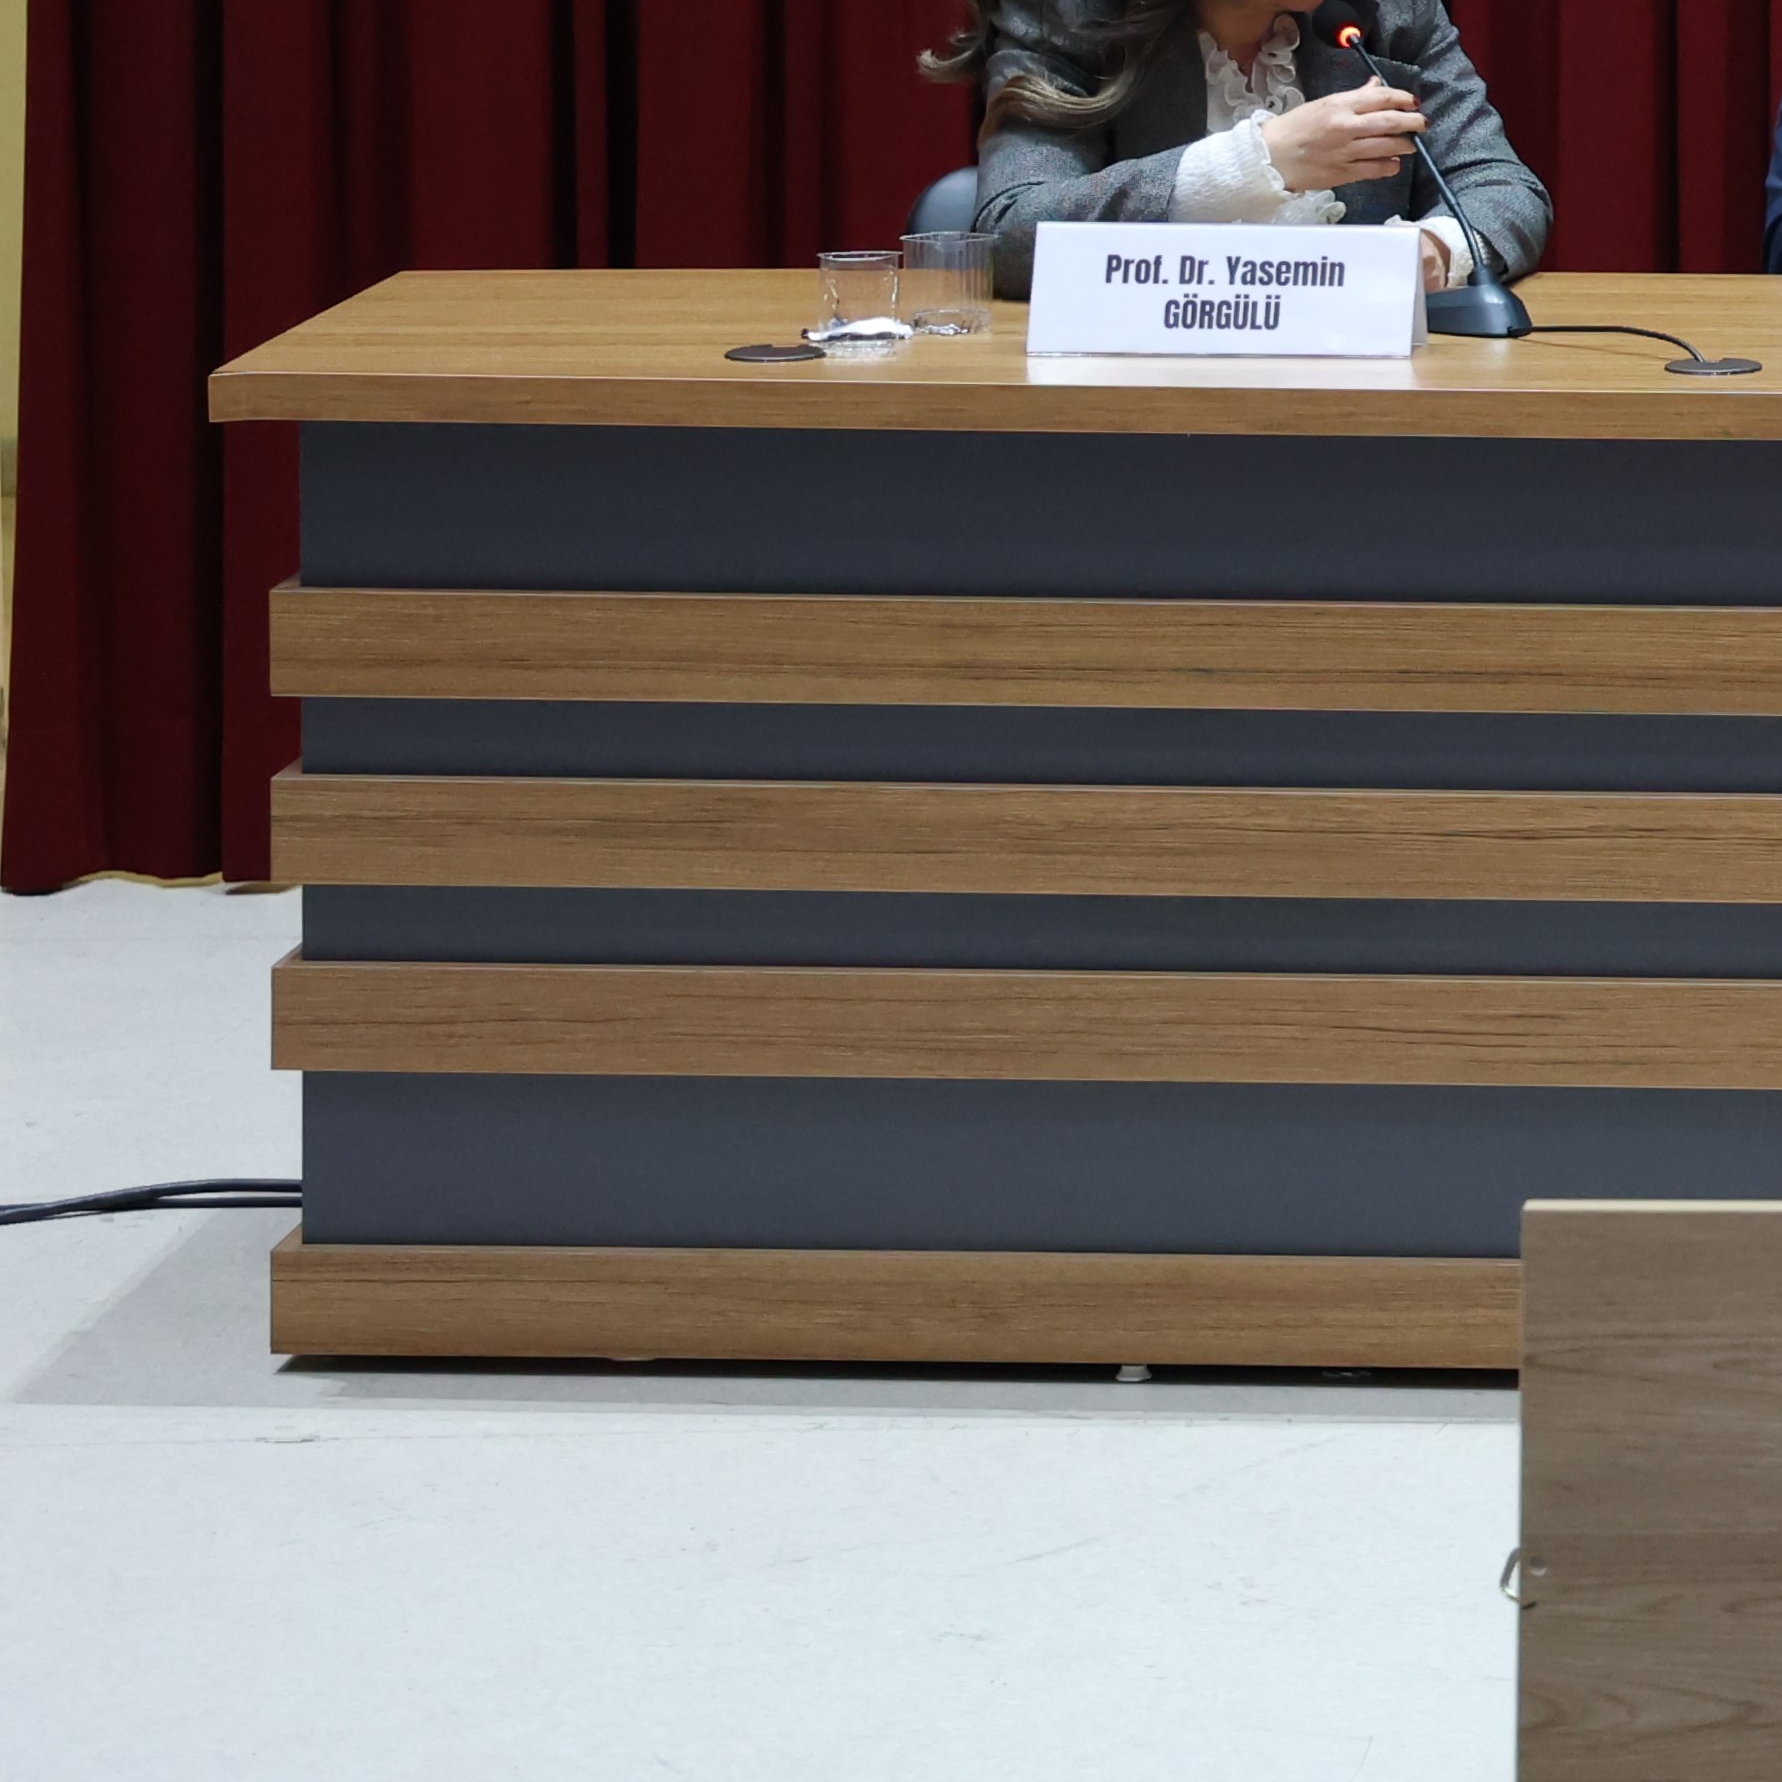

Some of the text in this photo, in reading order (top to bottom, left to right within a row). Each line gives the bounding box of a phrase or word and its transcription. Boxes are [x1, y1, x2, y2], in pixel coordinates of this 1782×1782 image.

[1105, 254, 1345, 287] Prof. Dr. Yasemin
[1163, 292, 1282, 331] GÖRGÜLÜ
